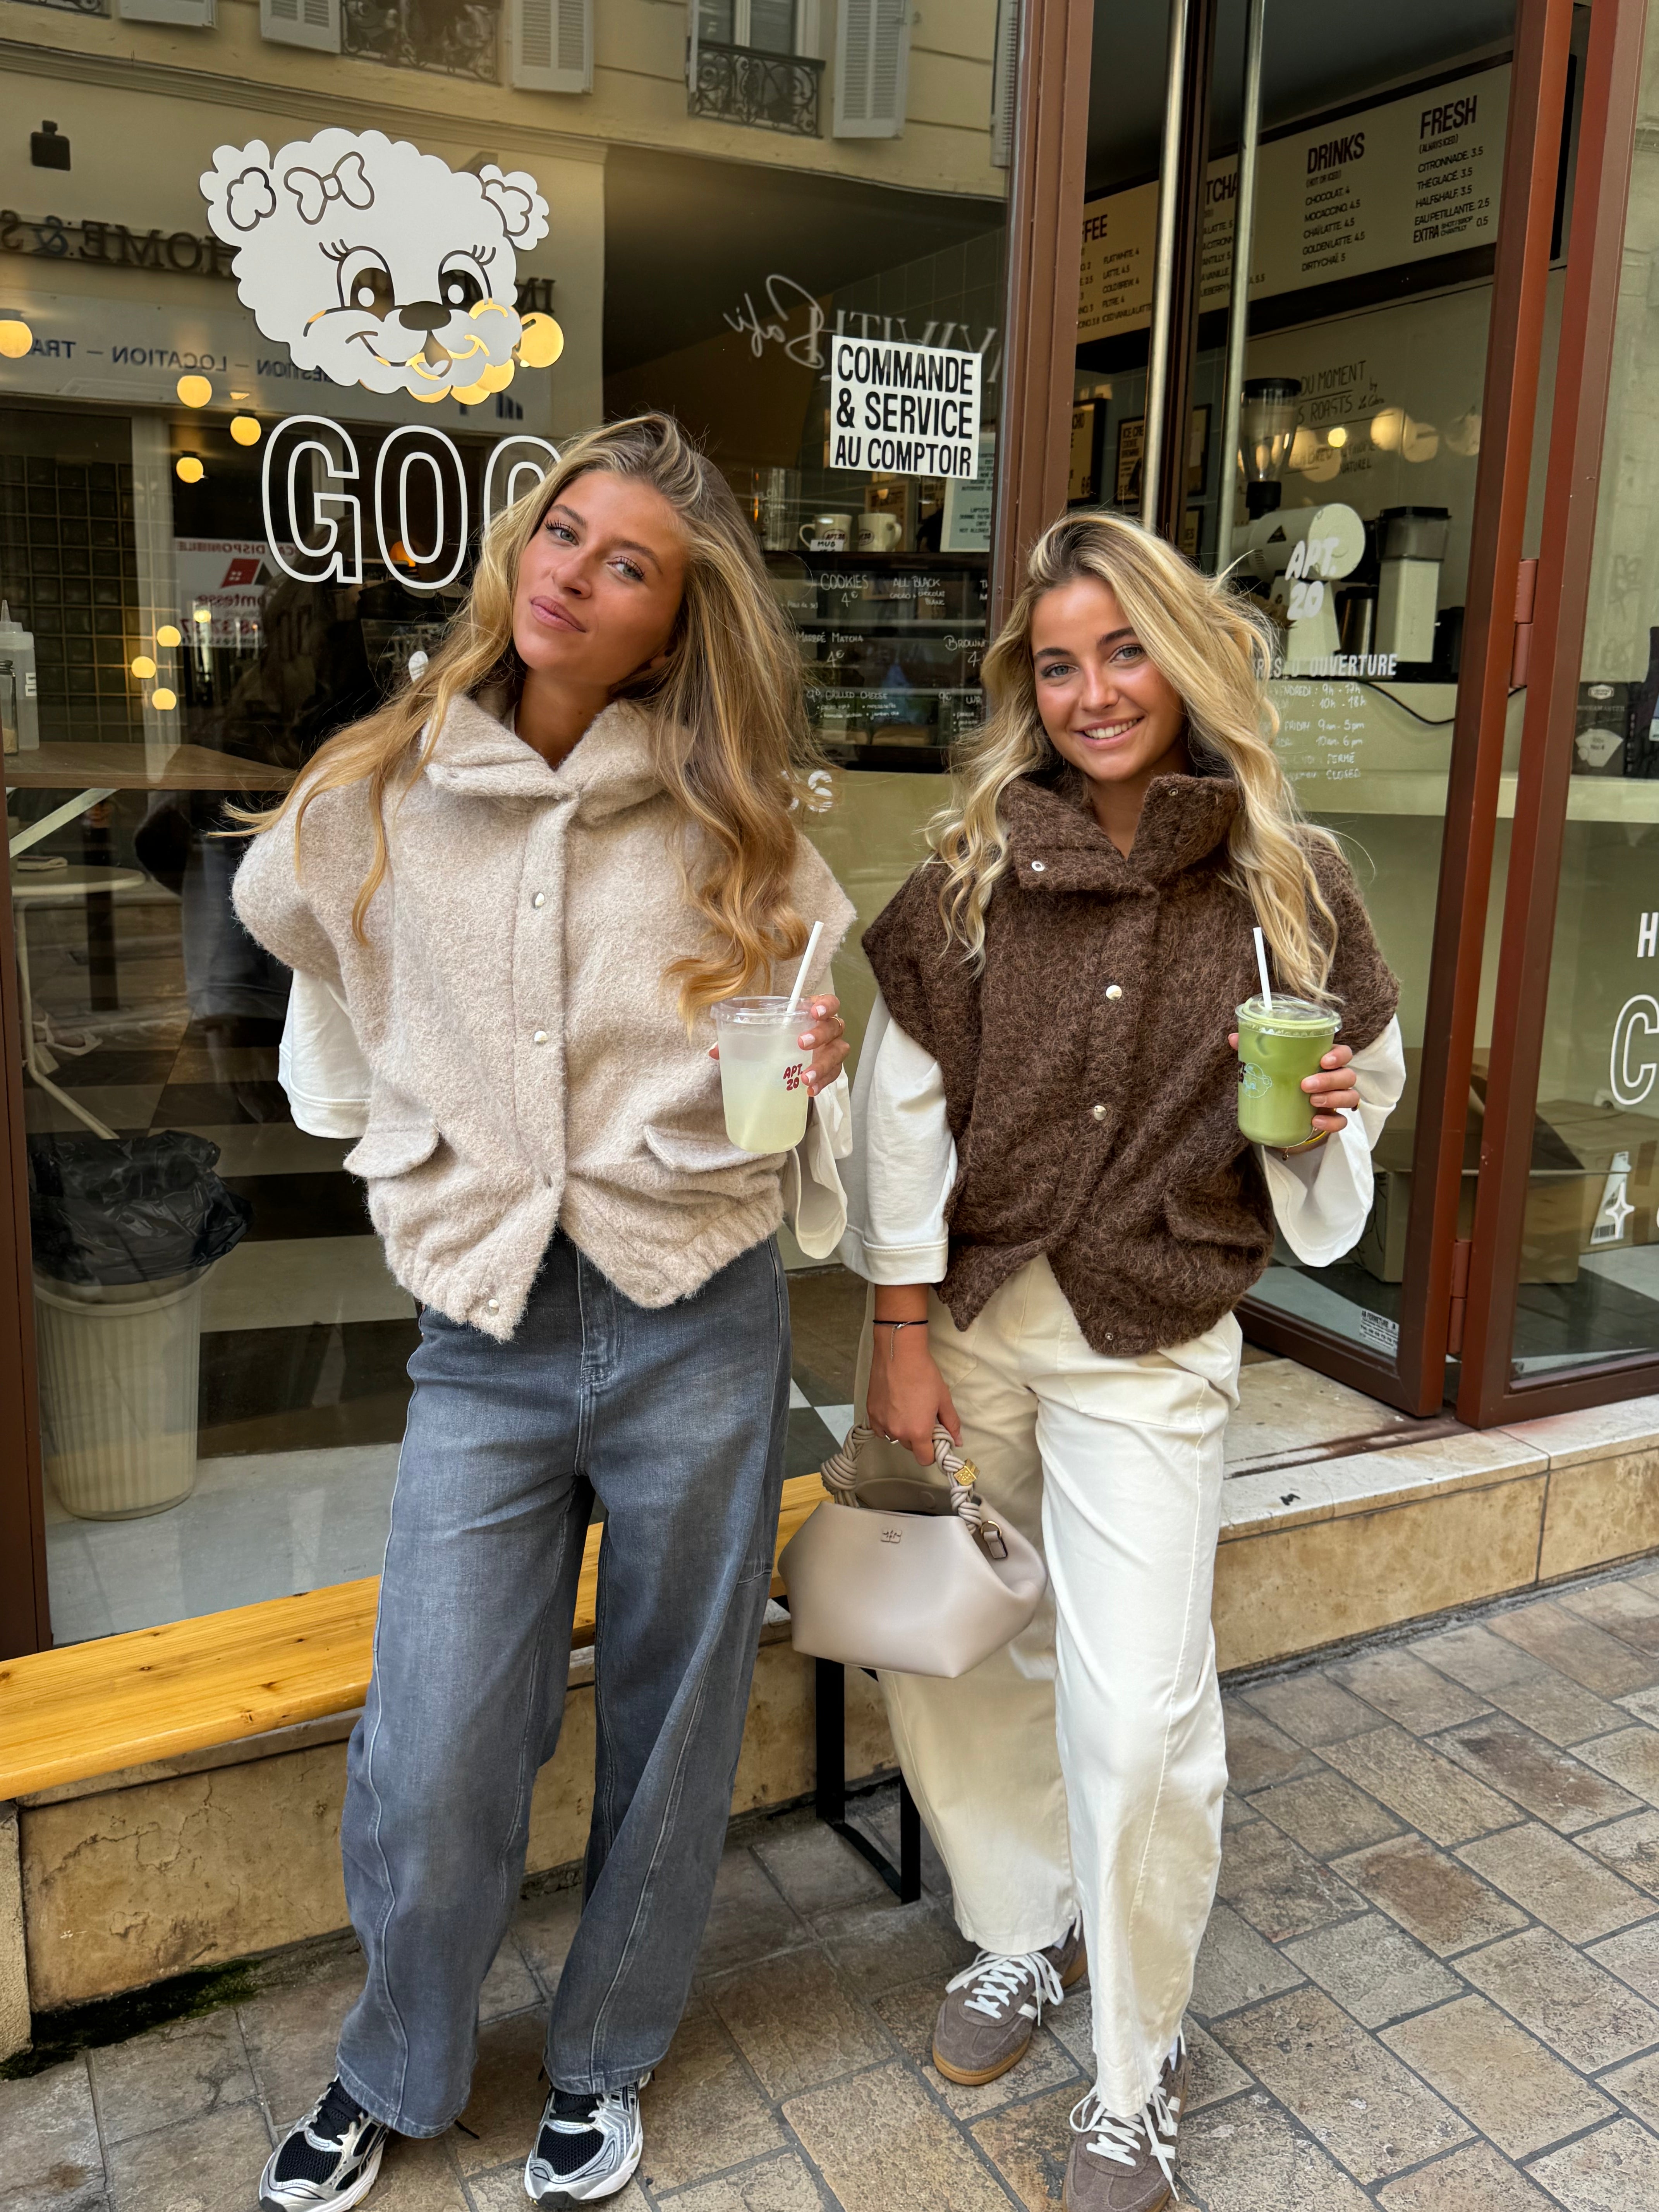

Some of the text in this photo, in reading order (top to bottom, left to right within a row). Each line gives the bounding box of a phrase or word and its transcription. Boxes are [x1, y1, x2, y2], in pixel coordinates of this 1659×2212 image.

[1420, 94, 1477, 139] FRESH
[1307, 132, 1365, 174] DRINKS
[1470, 146, 1484, 158] 3.5
[1460, 167, 1473, 179] 3.5
[1206, 172, 1238, 205] TCHA
[1461, 184, 1473, 196] 3.5
[1477, 197, 1490, 210] 2.5
[1083, 214, 1108, 243] FEE
[1413, 225, 1439, 244] EXTRA
[837, 344, 973, 395] COMMANDE
[1318, 360, 1367, 392] MOMENT
[836, 388, 972, 440] & SERVICE
[1310, 395, 1353, 422] ROASTS
[835, 435, 862, 467] AU
[867, 438, 972, 477] COMPTOIR
[1285, 537, 1340, 580] APT.
[820, 573, 940, 590] COOKIES ALL BLACK
[1287, 580, 1324, 620] 20
[1322, 683, 1334, 696] 9h
[1326, 751, 1355, 765] FERMÉ
[1637, 912, 1658, 958] H
[783, 1063, 803, 1079] APT.
[786, 1077, 799, 1091] 20
